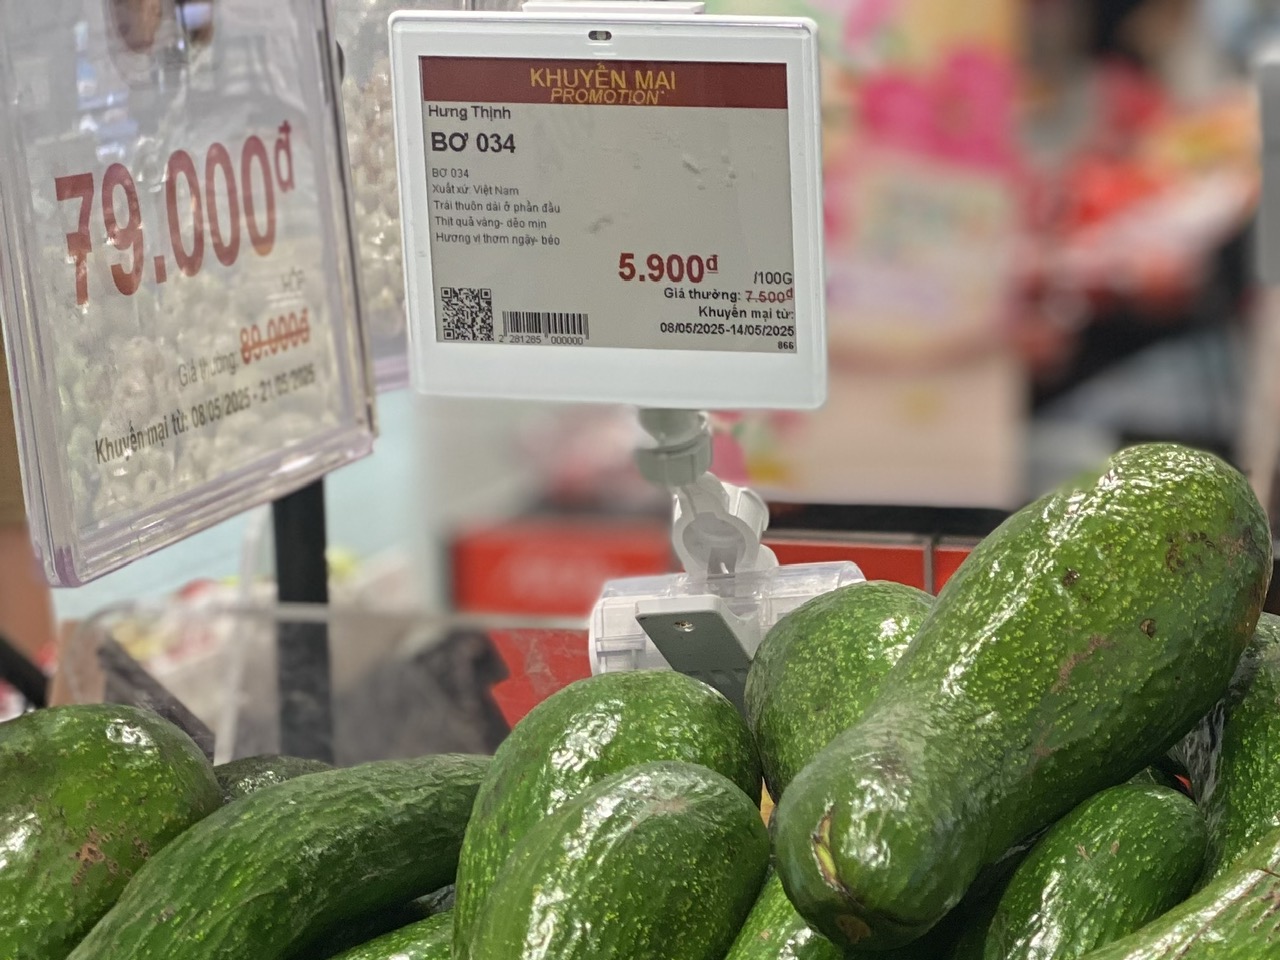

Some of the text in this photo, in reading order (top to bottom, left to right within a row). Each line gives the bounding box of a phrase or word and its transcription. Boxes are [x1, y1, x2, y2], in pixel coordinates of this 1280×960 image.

[550, 88, 660, 105] PROMOTION
[428, 105, 511, 121] Hưng Thịnh
[431, 131, 516, 153] BƠ 034
[431, 168, 469, 178] BƠ 034
[432, 182, 455, 194] Xuất
[473, 183, 493, 196] Việt
[495, 185, 519, 196] Nam
[55, 119, 296, 306] 79.000đ
[436, 232, 471, 245] Hương
[483, 233, 509, 244] thơm
[753, 271, 793, 285] /100G
[664, 287, 685, 299] Giá
[689, 288, 741, 302] thường:
[751, 307, 772, 322] mại
[660, 322, 795, 336] 08/05/2025-14/05/2025
[499, 334, 584, 345] 2 281285 000000
[777, 341, 794, 350] 866
[147, 414, 169, 447] mại
